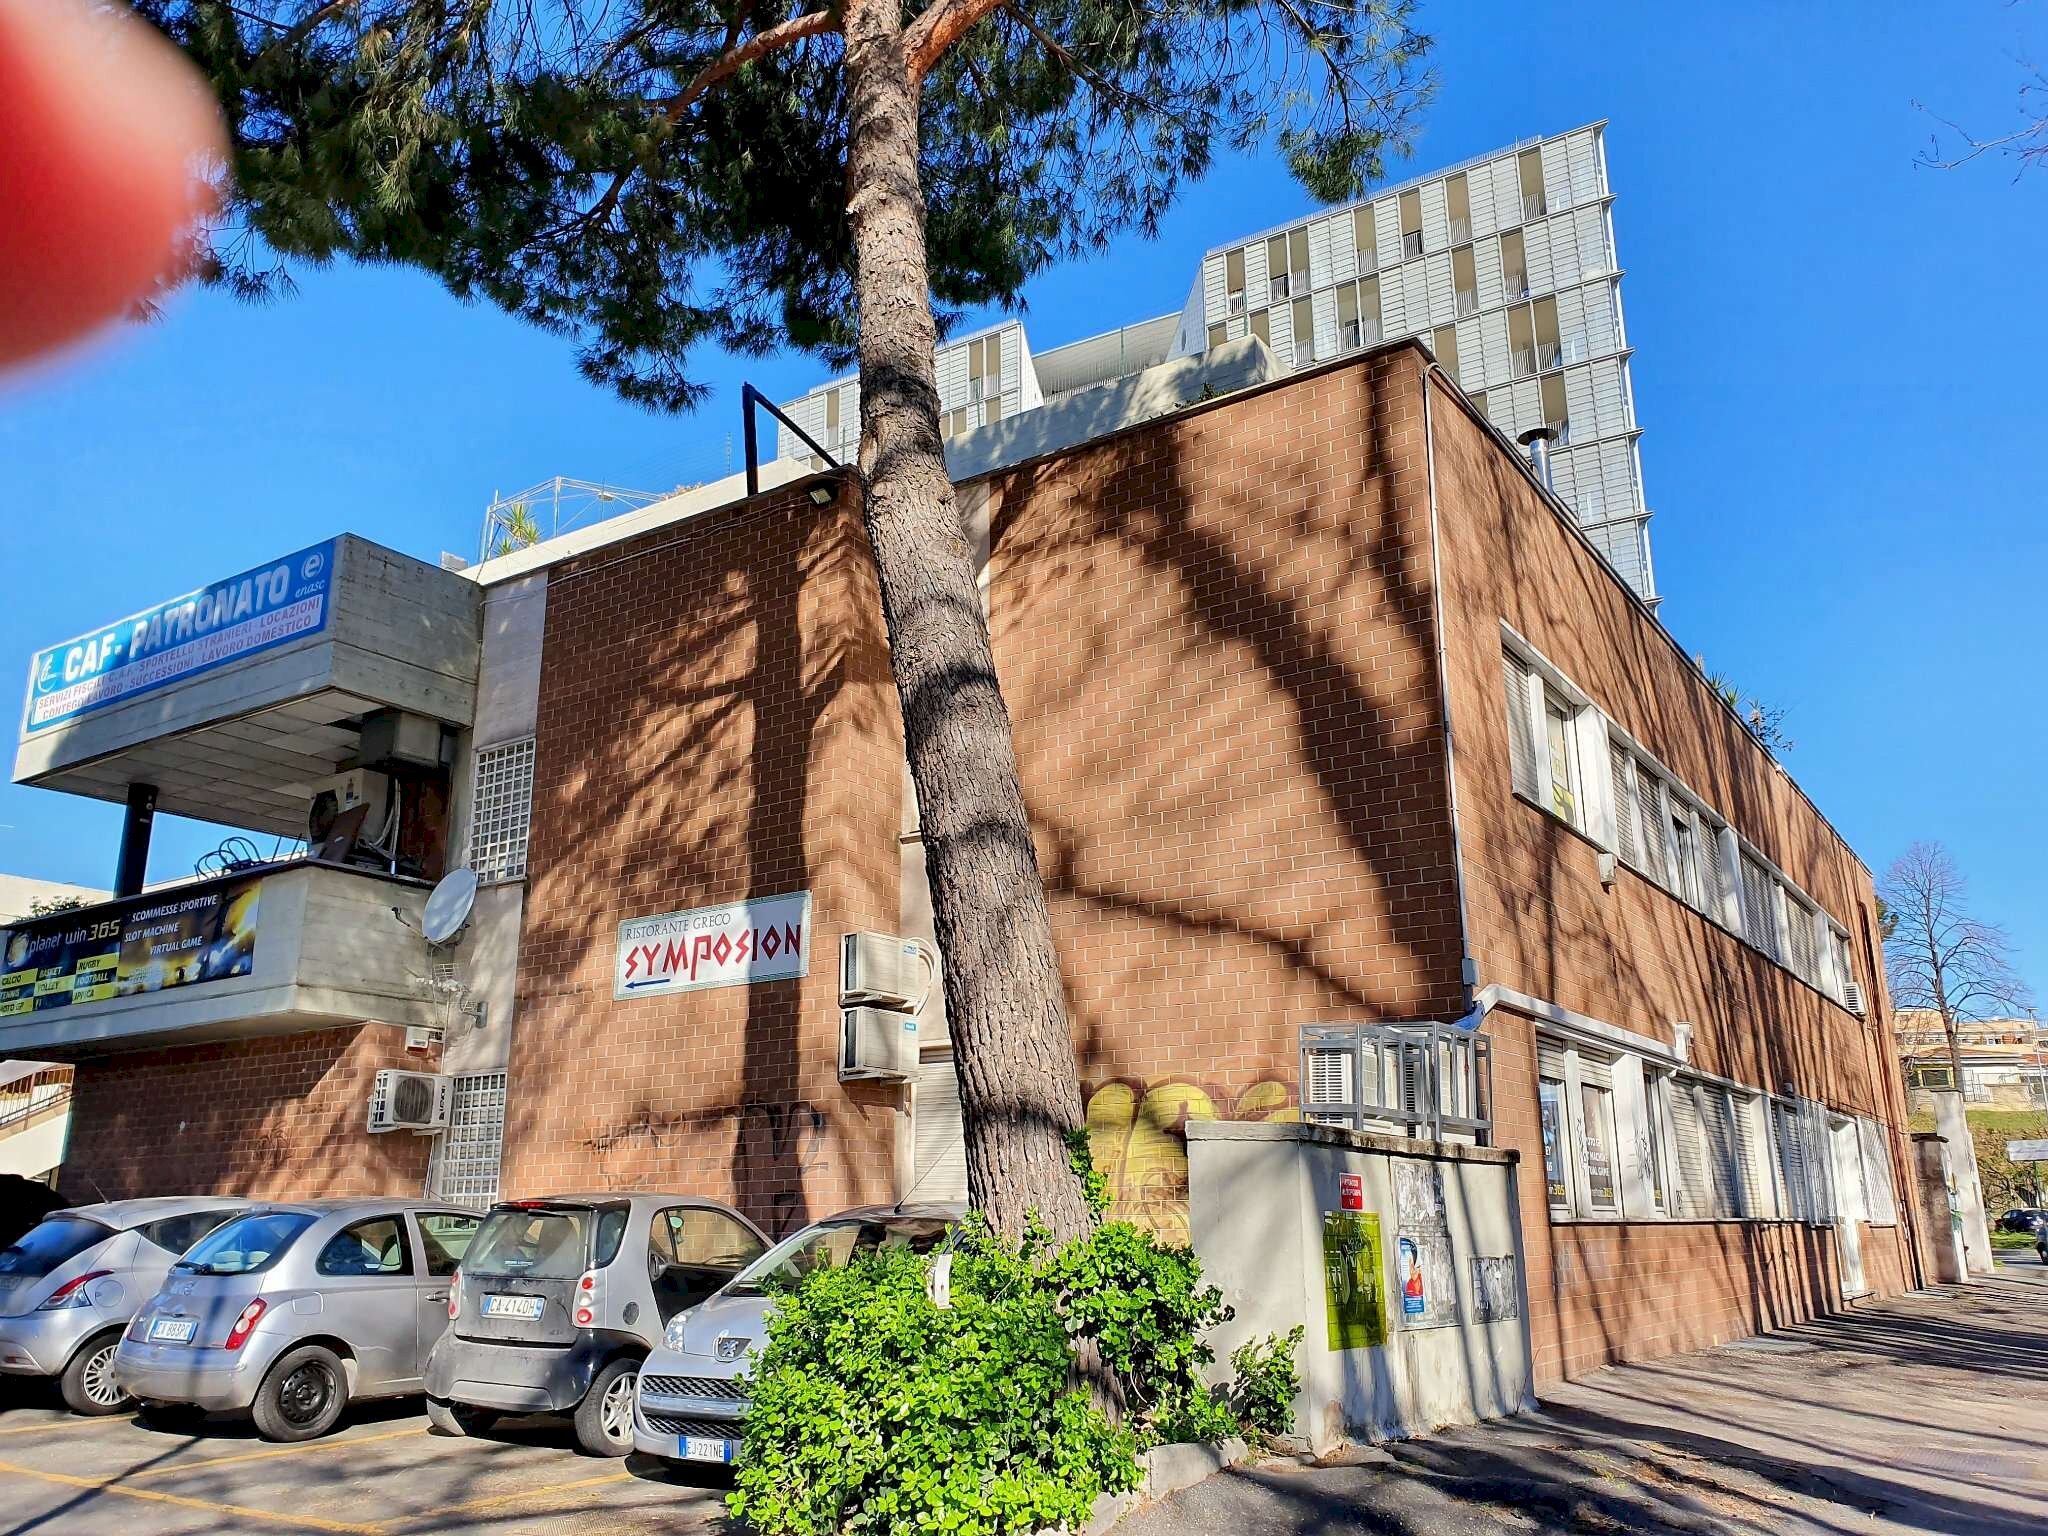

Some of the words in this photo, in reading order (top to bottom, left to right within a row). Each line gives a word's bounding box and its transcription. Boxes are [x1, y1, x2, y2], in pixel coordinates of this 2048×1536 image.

[129, 564, 290, 658] PATRONATO
[39, 685, 72, 709] SERVIZI
[139, 643, 193, 672] SPORTELLO
[198, 623, 251, 648] STRANIERI
[260, 597, 320, 627] LOCAZIONI
[129, 658, 193, 688] SUCCESSIONI
[202, 641, 243, 662] LAVORO
[246, 615, 312, 646] DOMESTICO
[131, 903, 178, 922] SCOMMESSE
[180, 894, 219, 912] SPORTIVE
[125, 930, 141, 942] SLOT
[143, 922, 180, 938] MACHINE
[626, 920, 689, 940] RISTORANTE
[693, 913, 731, 929] GRECO
[29, 932, 62, 957] planet
[151, 943, 180, 956] VIRTUAL
[181, 936, 203, 948] GAME
[625, 920, 801, 981] SYMPOSION
[78, 959, 101, 971] RUGBY
[1, 975, 22, 986] CALCIO
